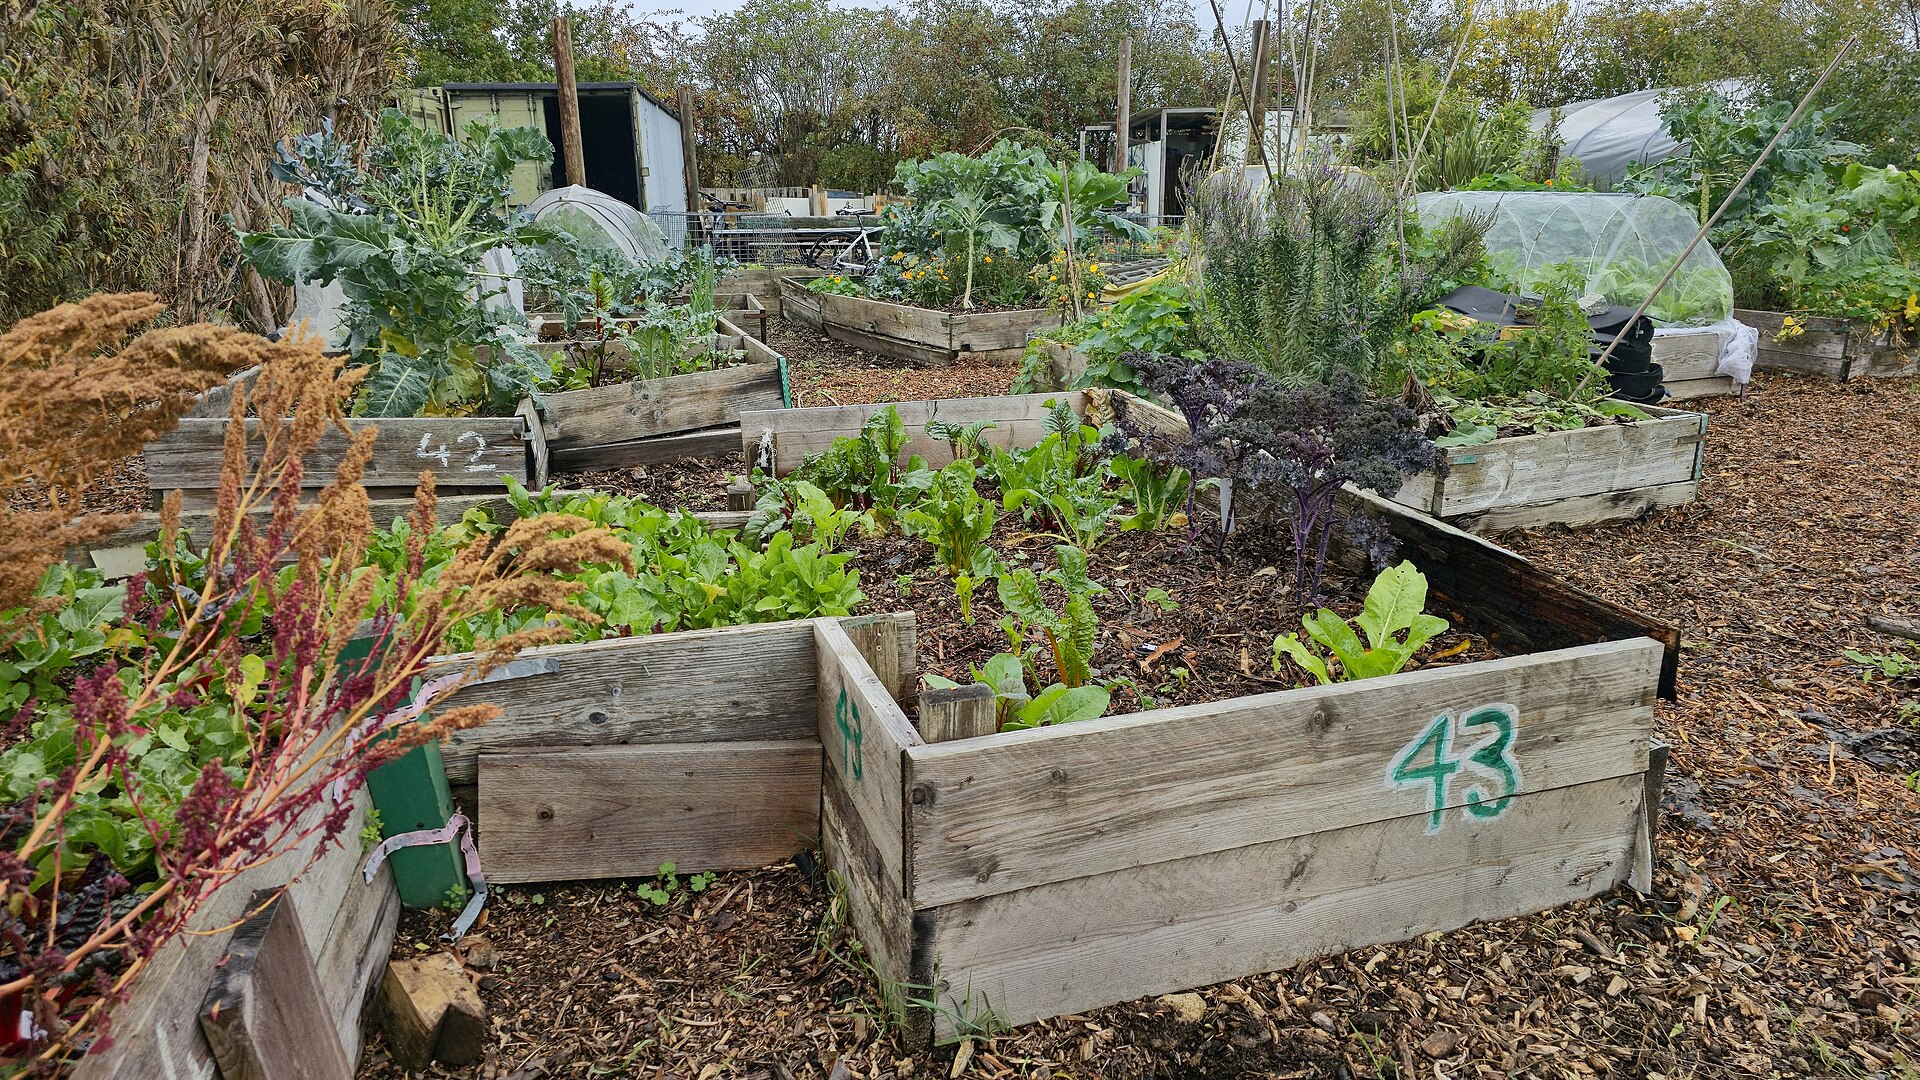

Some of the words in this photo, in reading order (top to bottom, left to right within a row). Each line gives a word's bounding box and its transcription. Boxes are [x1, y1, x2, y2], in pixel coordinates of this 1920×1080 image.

[417, 431, 497, 472] 42
[836, 687, 862, 781] 43
[1385, 703, 1522, 836] 43
